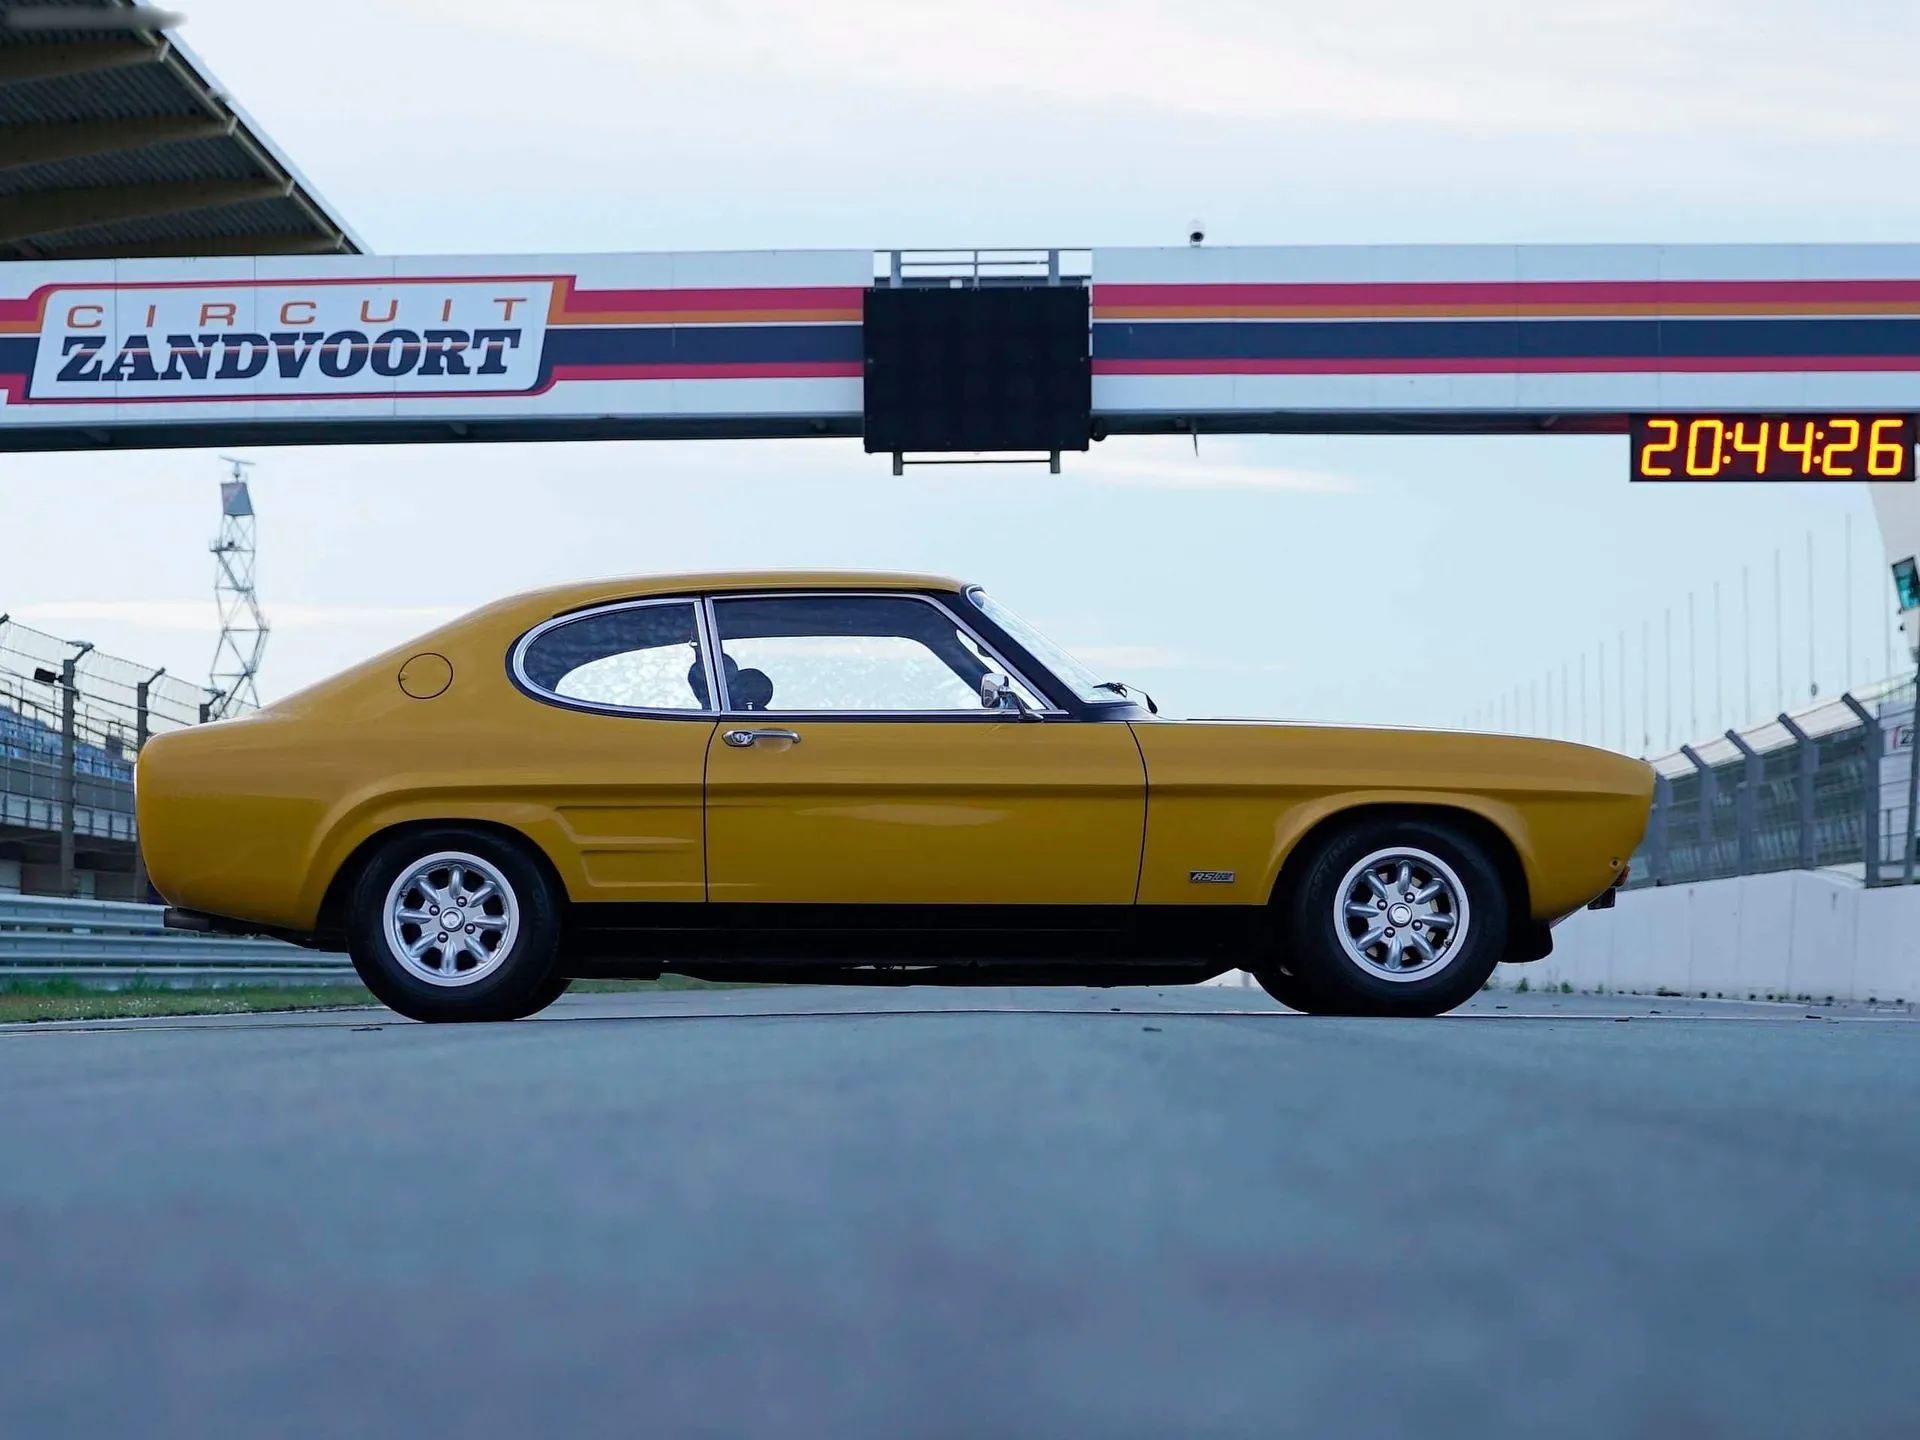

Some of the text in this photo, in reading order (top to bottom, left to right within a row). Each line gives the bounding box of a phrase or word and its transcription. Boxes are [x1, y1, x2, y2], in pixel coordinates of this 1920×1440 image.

[67, 298, 528, 328] CIRCUIT
[56, 328, 522, 382] ZANDVOORT
[1640, 419, 1904, 476] 20:44:26
